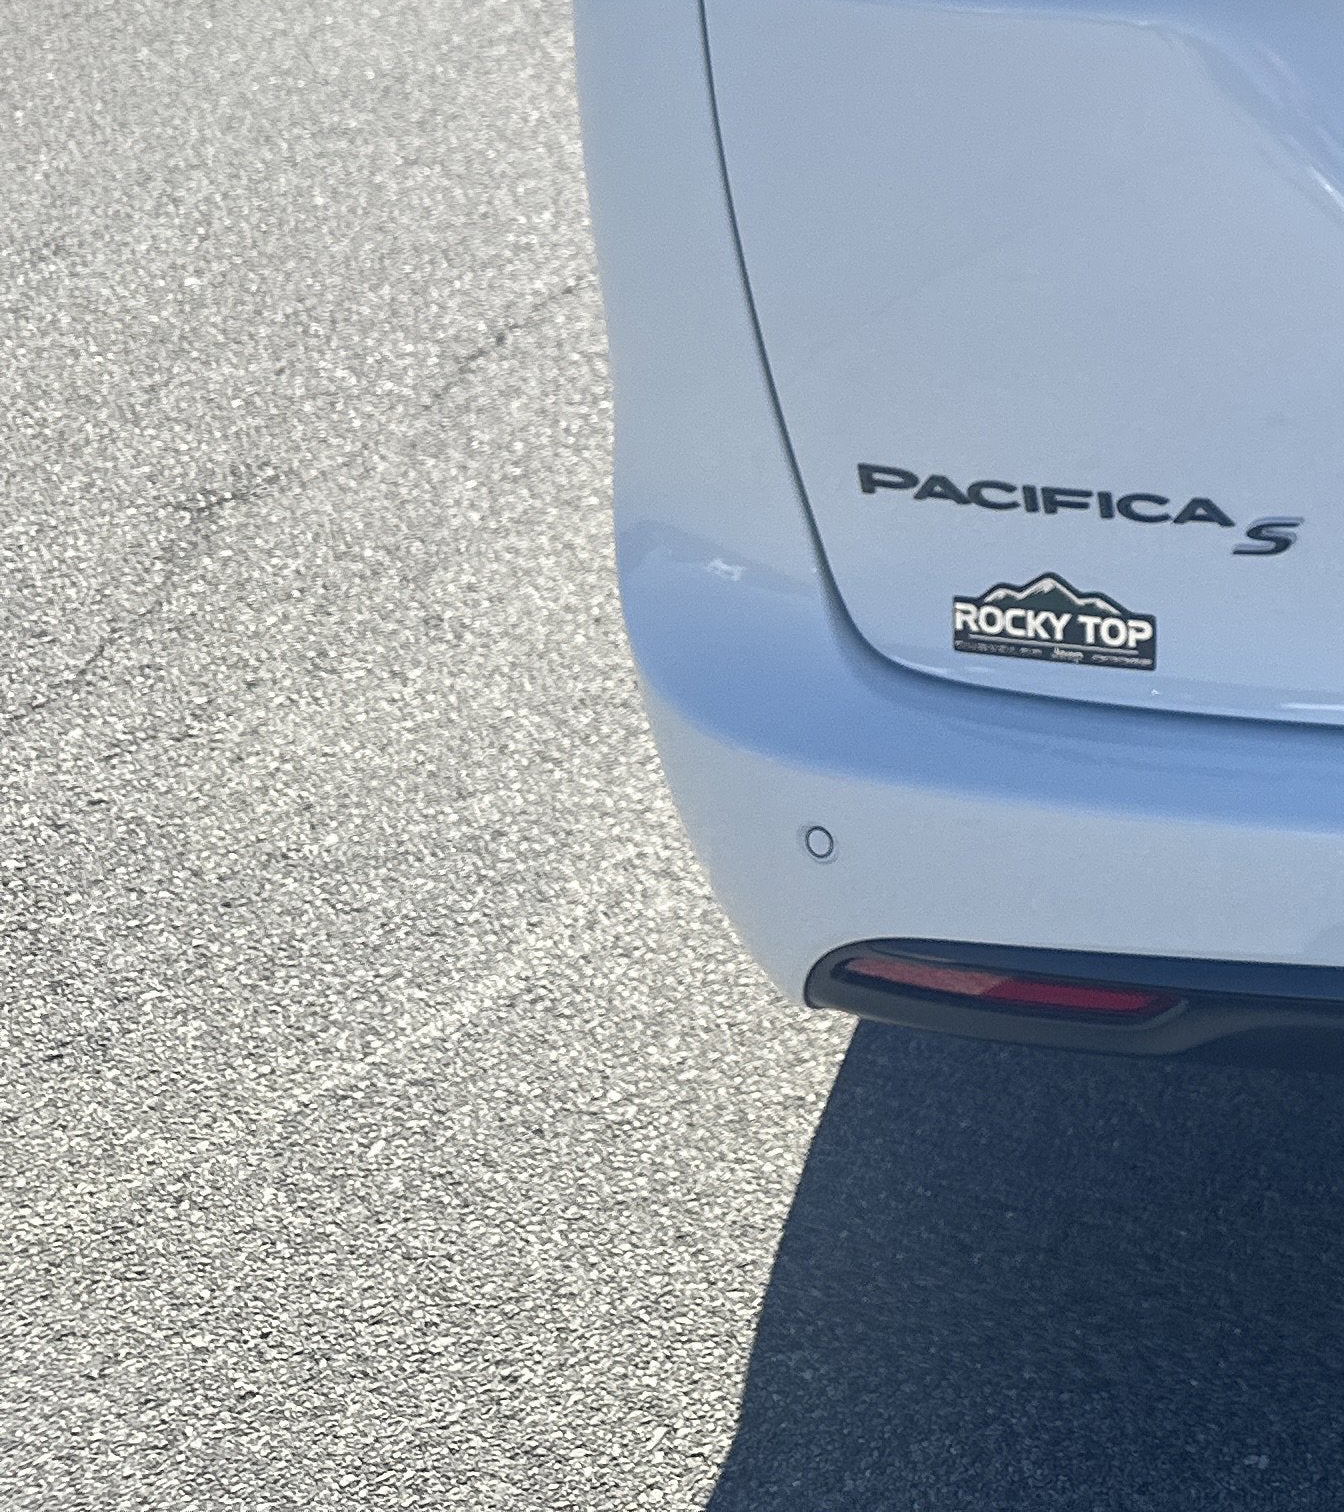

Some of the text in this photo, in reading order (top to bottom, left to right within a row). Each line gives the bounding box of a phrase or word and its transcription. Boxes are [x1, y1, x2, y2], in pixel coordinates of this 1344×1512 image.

[856, 462, 1305, 556] PACIFICA S
[953, 601, 1073, 641] ROCKY
[1077, 614, 1154, 648] TOP
